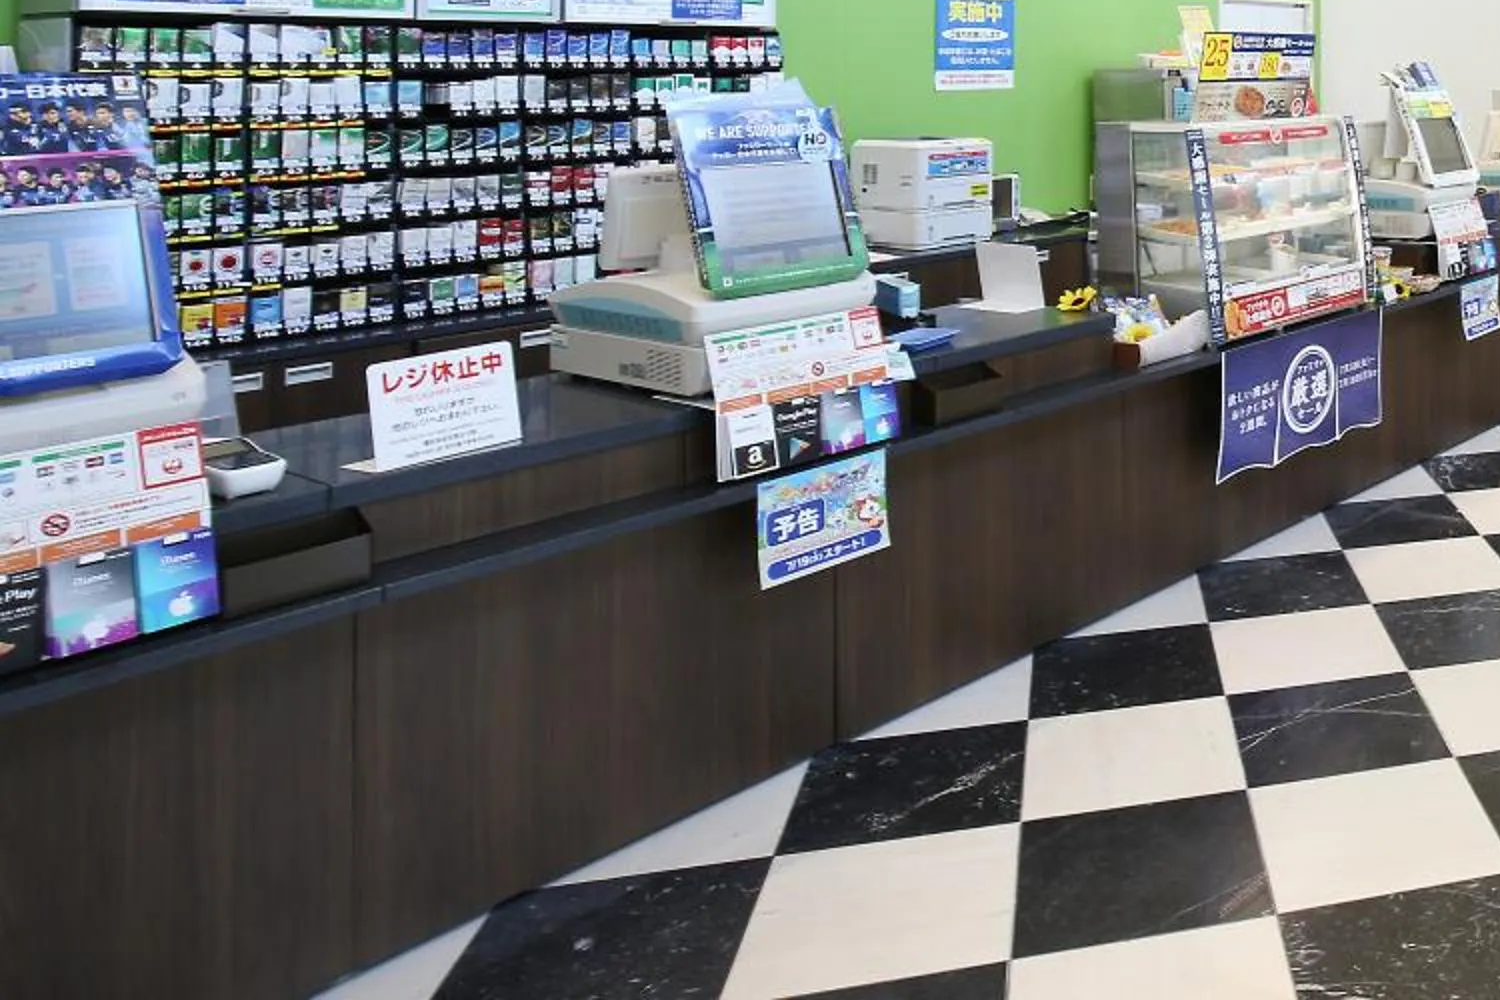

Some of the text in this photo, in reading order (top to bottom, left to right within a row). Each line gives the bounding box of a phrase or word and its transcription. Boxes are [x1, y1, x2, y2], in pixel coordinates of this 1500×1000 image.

[948, 0, 1003, 24] 実施中
[719, 124, 745, 139] ARE
[382, 352, 502, 394] レジ休止中
[772, 506, 820, 541] 予告
